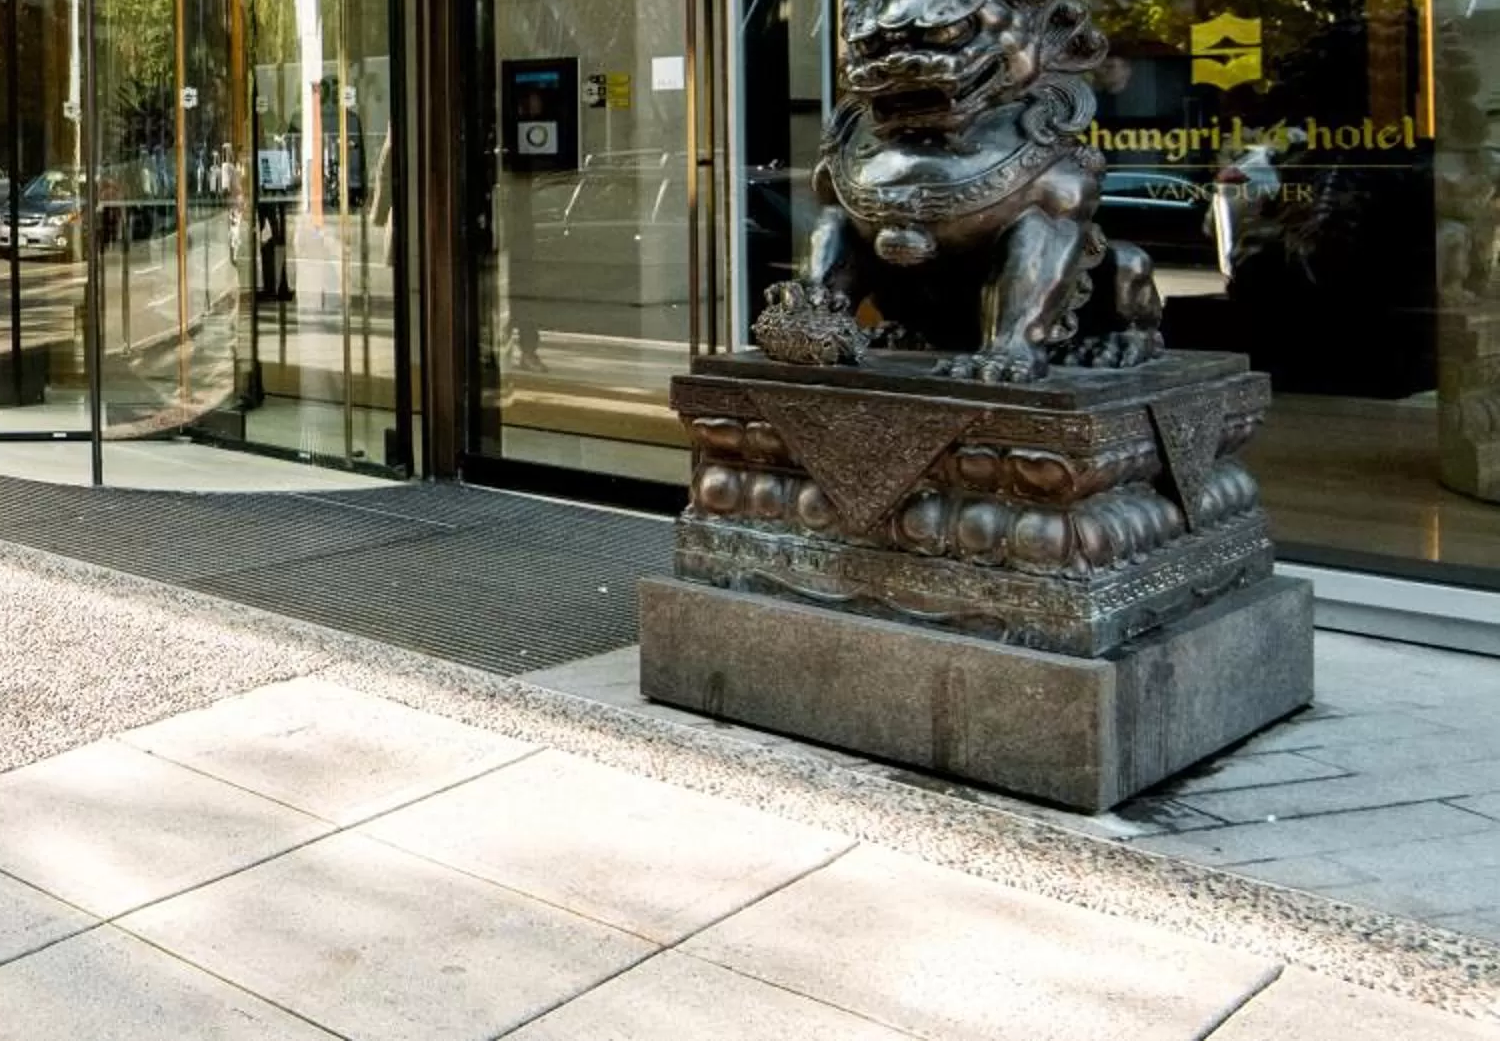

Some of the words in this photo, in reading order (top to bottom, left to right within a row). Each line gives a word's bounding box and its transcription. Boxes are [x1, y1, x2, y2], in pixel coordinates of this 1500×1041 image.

[1076, 115, 1289, 162] hangri-La
[1305, 115, 1416, 151] hotel
[1145, 181, 1314, 203] VANCOUVER
